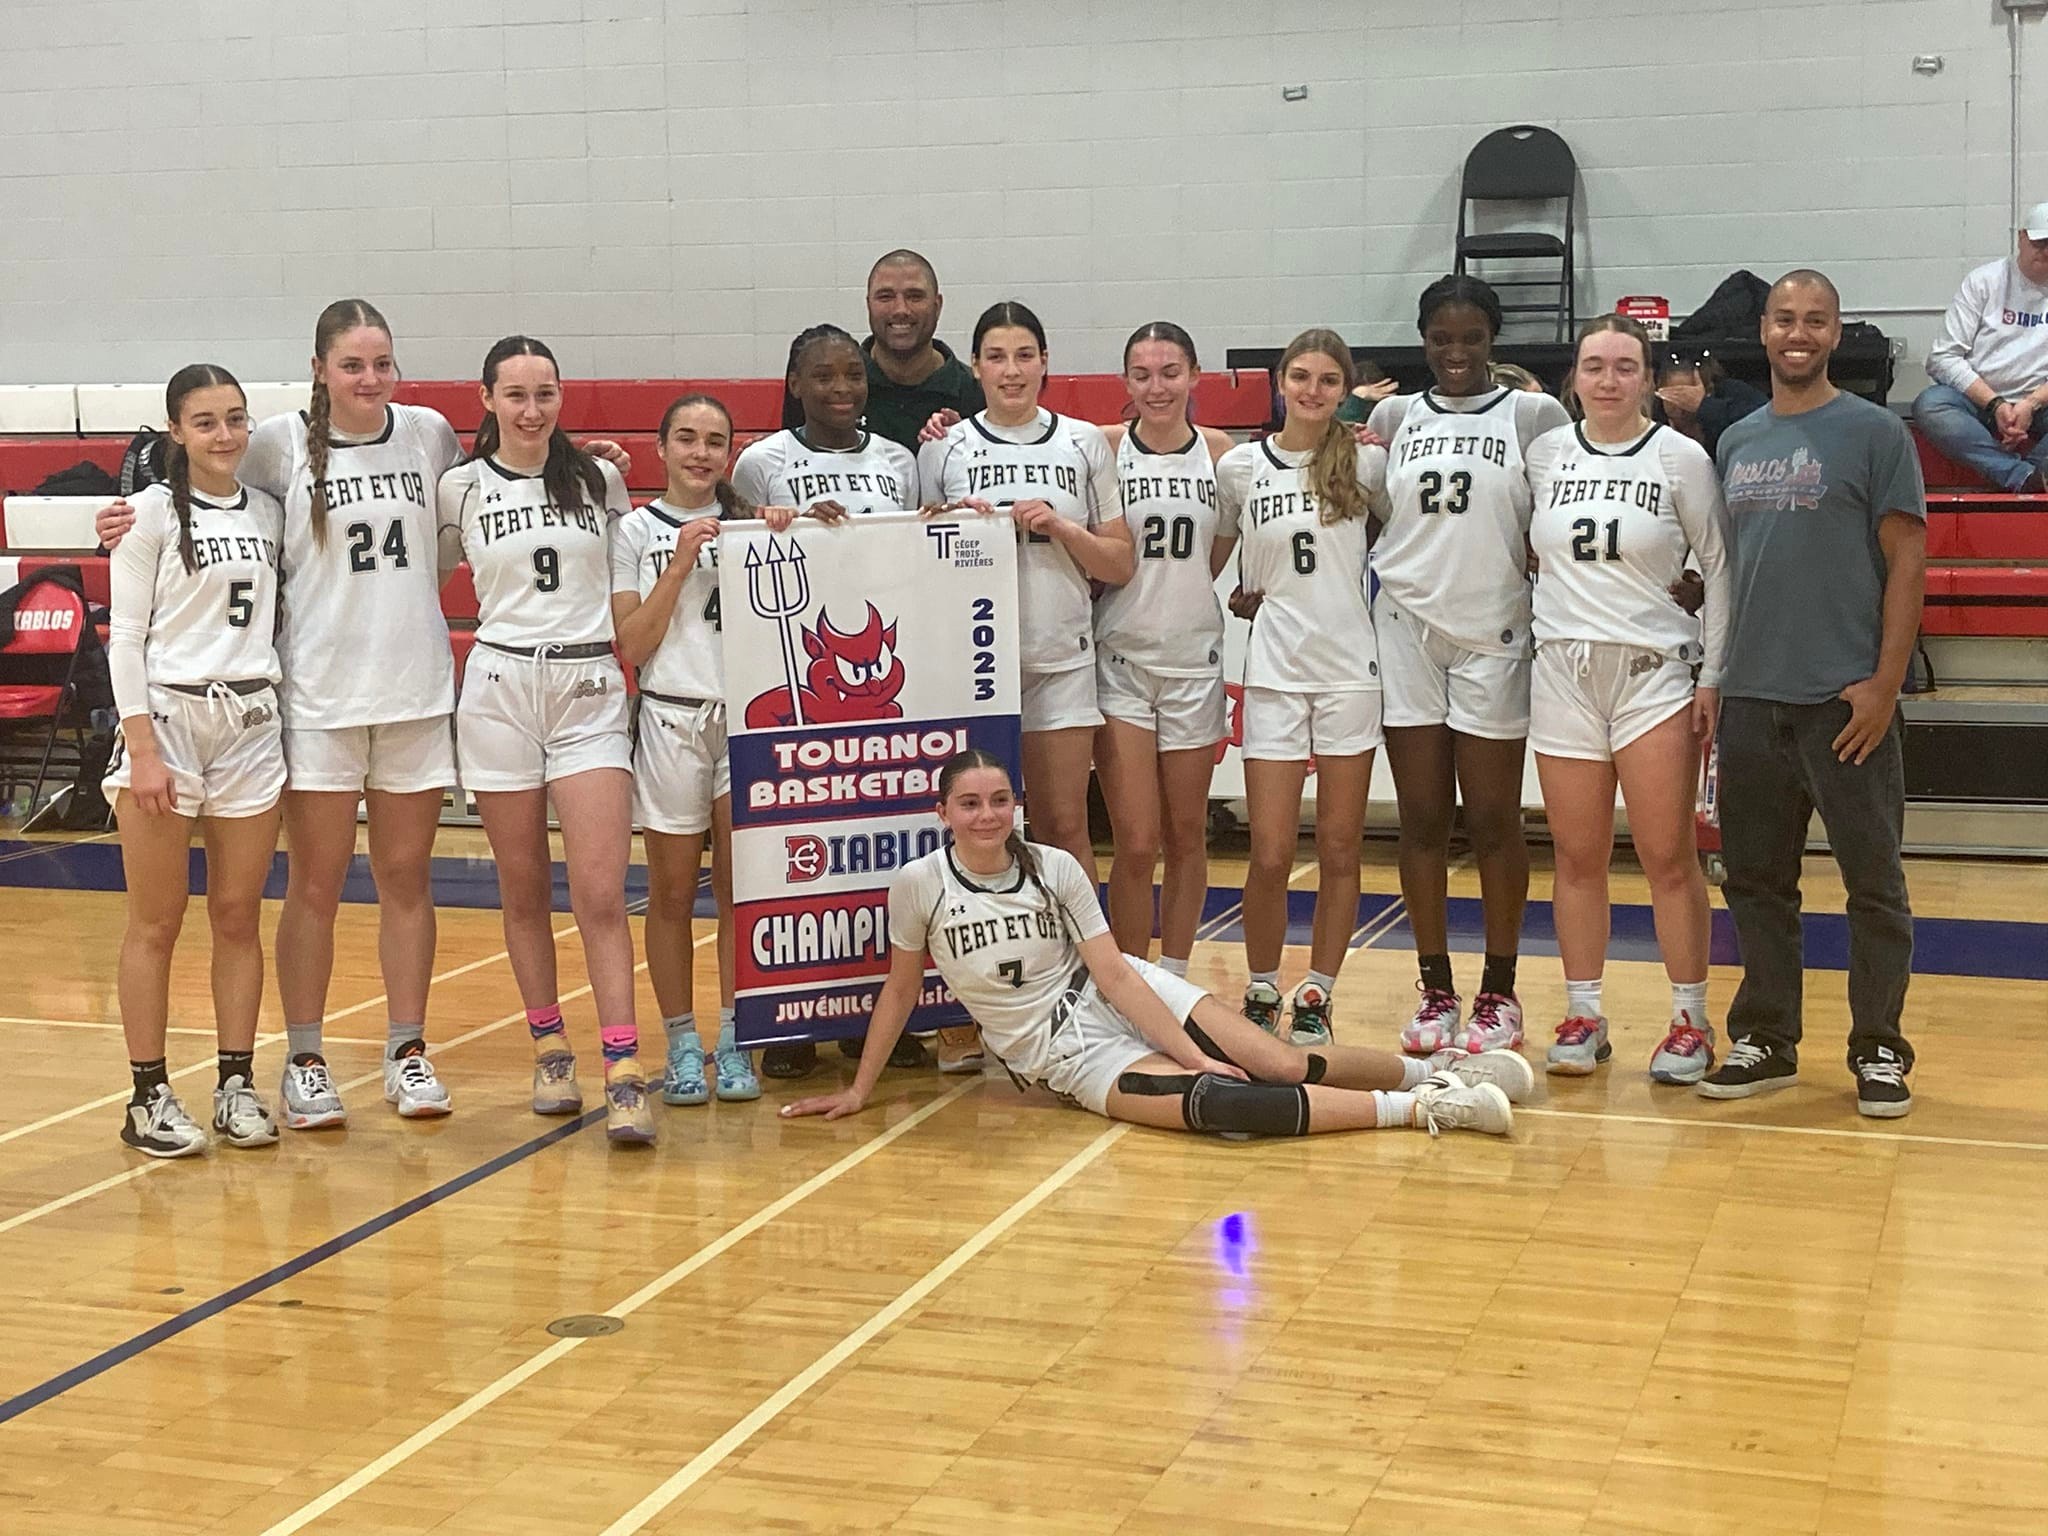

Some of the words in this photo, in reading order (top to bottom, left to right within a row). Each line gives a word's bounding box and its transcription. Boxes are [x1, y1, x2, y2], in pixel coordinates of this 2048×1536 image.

[2002, 307, 2048, 328] DIABL
[1400, 436, 1449, 467] VERT
[1452, 436, 1479, 455] ET
[1482, 436, 1506, 468] OR
[368, 472, 397, 499] ET
[400, 471, 426, 509] OR
[787, 473, 842, 506] VERT
[845, 473, 873, 492] ET
[876, 474, 900, 505] OR
[967, 464, 1017, 495] VERT
[1024, 464, 1049, 484] ET
[1055, 465, 1078, 497] OR
[1168, 476, 1192, 499] ET
[1196, 477, 1217, 511] OR
[1418, 470, 1472, 514] 23
[1549, 479, 1601, 510] VERT
[1604, 479, 1632, 502] ET
[1635, 481, 1661, 517] OR
[478, 505, 534, 546] VERT
[1249, 493, 1296, 532] VERT
[193, 536, 232, 570] ERT
[235, 536, 262, 562] ET
[347, 518, 408, 573] 24
[954, 540, 980, 549] CÉGEP
[1142, 515, 1194, 559] 20
[1291, 530, 1316, 575] 6
[1571, 517, 1622, 561] 21
[533, 546, 561, 593] 9
[228, 580, 254, 628] 5
[703, 586, 722, 633] 4
[971, 598, 996, 702] 2023
[774, 729, 969, 769] TOURNOI
[749, 767, 944, 809] BASKETB
[752, 905, 885, 966] CHAMPI
[943, 918, 999, 960] VERT
[1003, 913, 1031, 940] ET
[1035, 911, 1058, 939] OR
[997, 959, 1023, 989] 7
[775, 993, 873, 1023] JUVÉNILE
